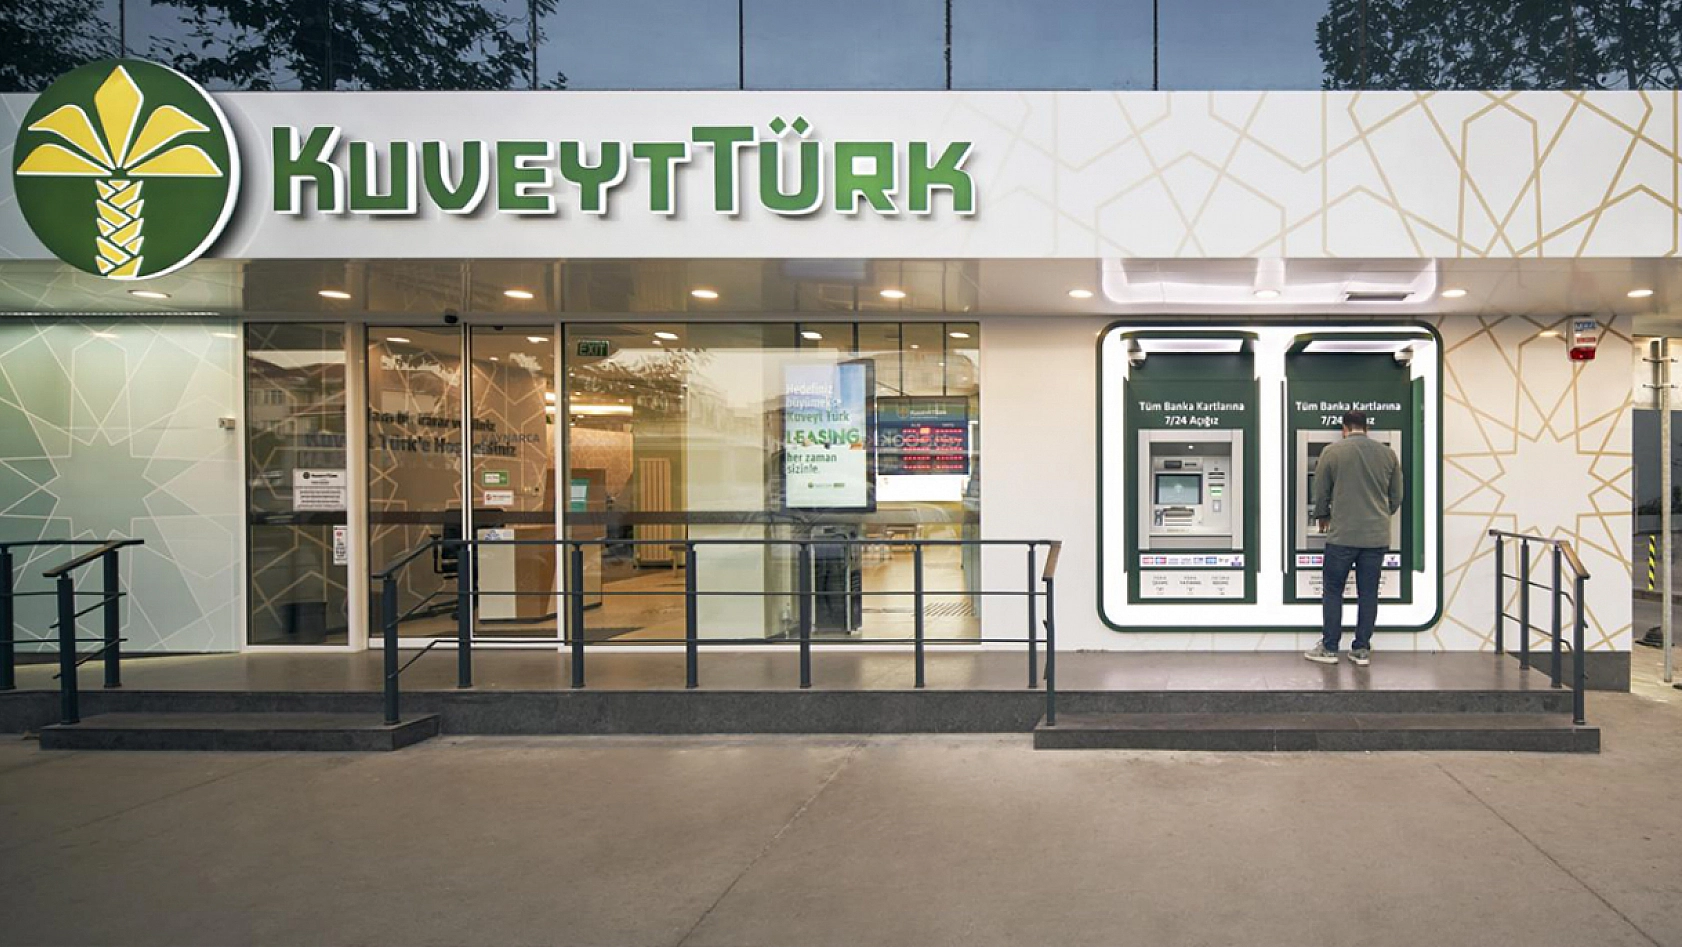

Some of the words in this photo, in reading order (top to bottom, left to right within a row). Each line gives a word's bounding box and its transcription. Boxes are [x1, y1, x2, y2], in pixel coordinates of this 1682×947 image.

[579, 342, 607, 356] EXIT
[1138, 401, 1161, 411] Tüm
[1164, 401, 1194, 411] Banka
[1196, 401, 1245, 411] Kartlarına
[1295, 401, 1318, 411] Tüm
[1320, 401, 1350, 411] Banka
[1352, 401, 1402, 411] Kartlarına
[786, 410, 823, 424] Kuveyt
[826, 409, 850, 422] Türk
[1165, 416, 1188, 426] 7/24
[1189, 416, 1219, 427] Açığız
[1321, 415, 1344, 426] 7/24
[787, 428, 860, 444] LEASING
[786, 452, 804, 462] her
[805, 453, 838, 462] zaman
